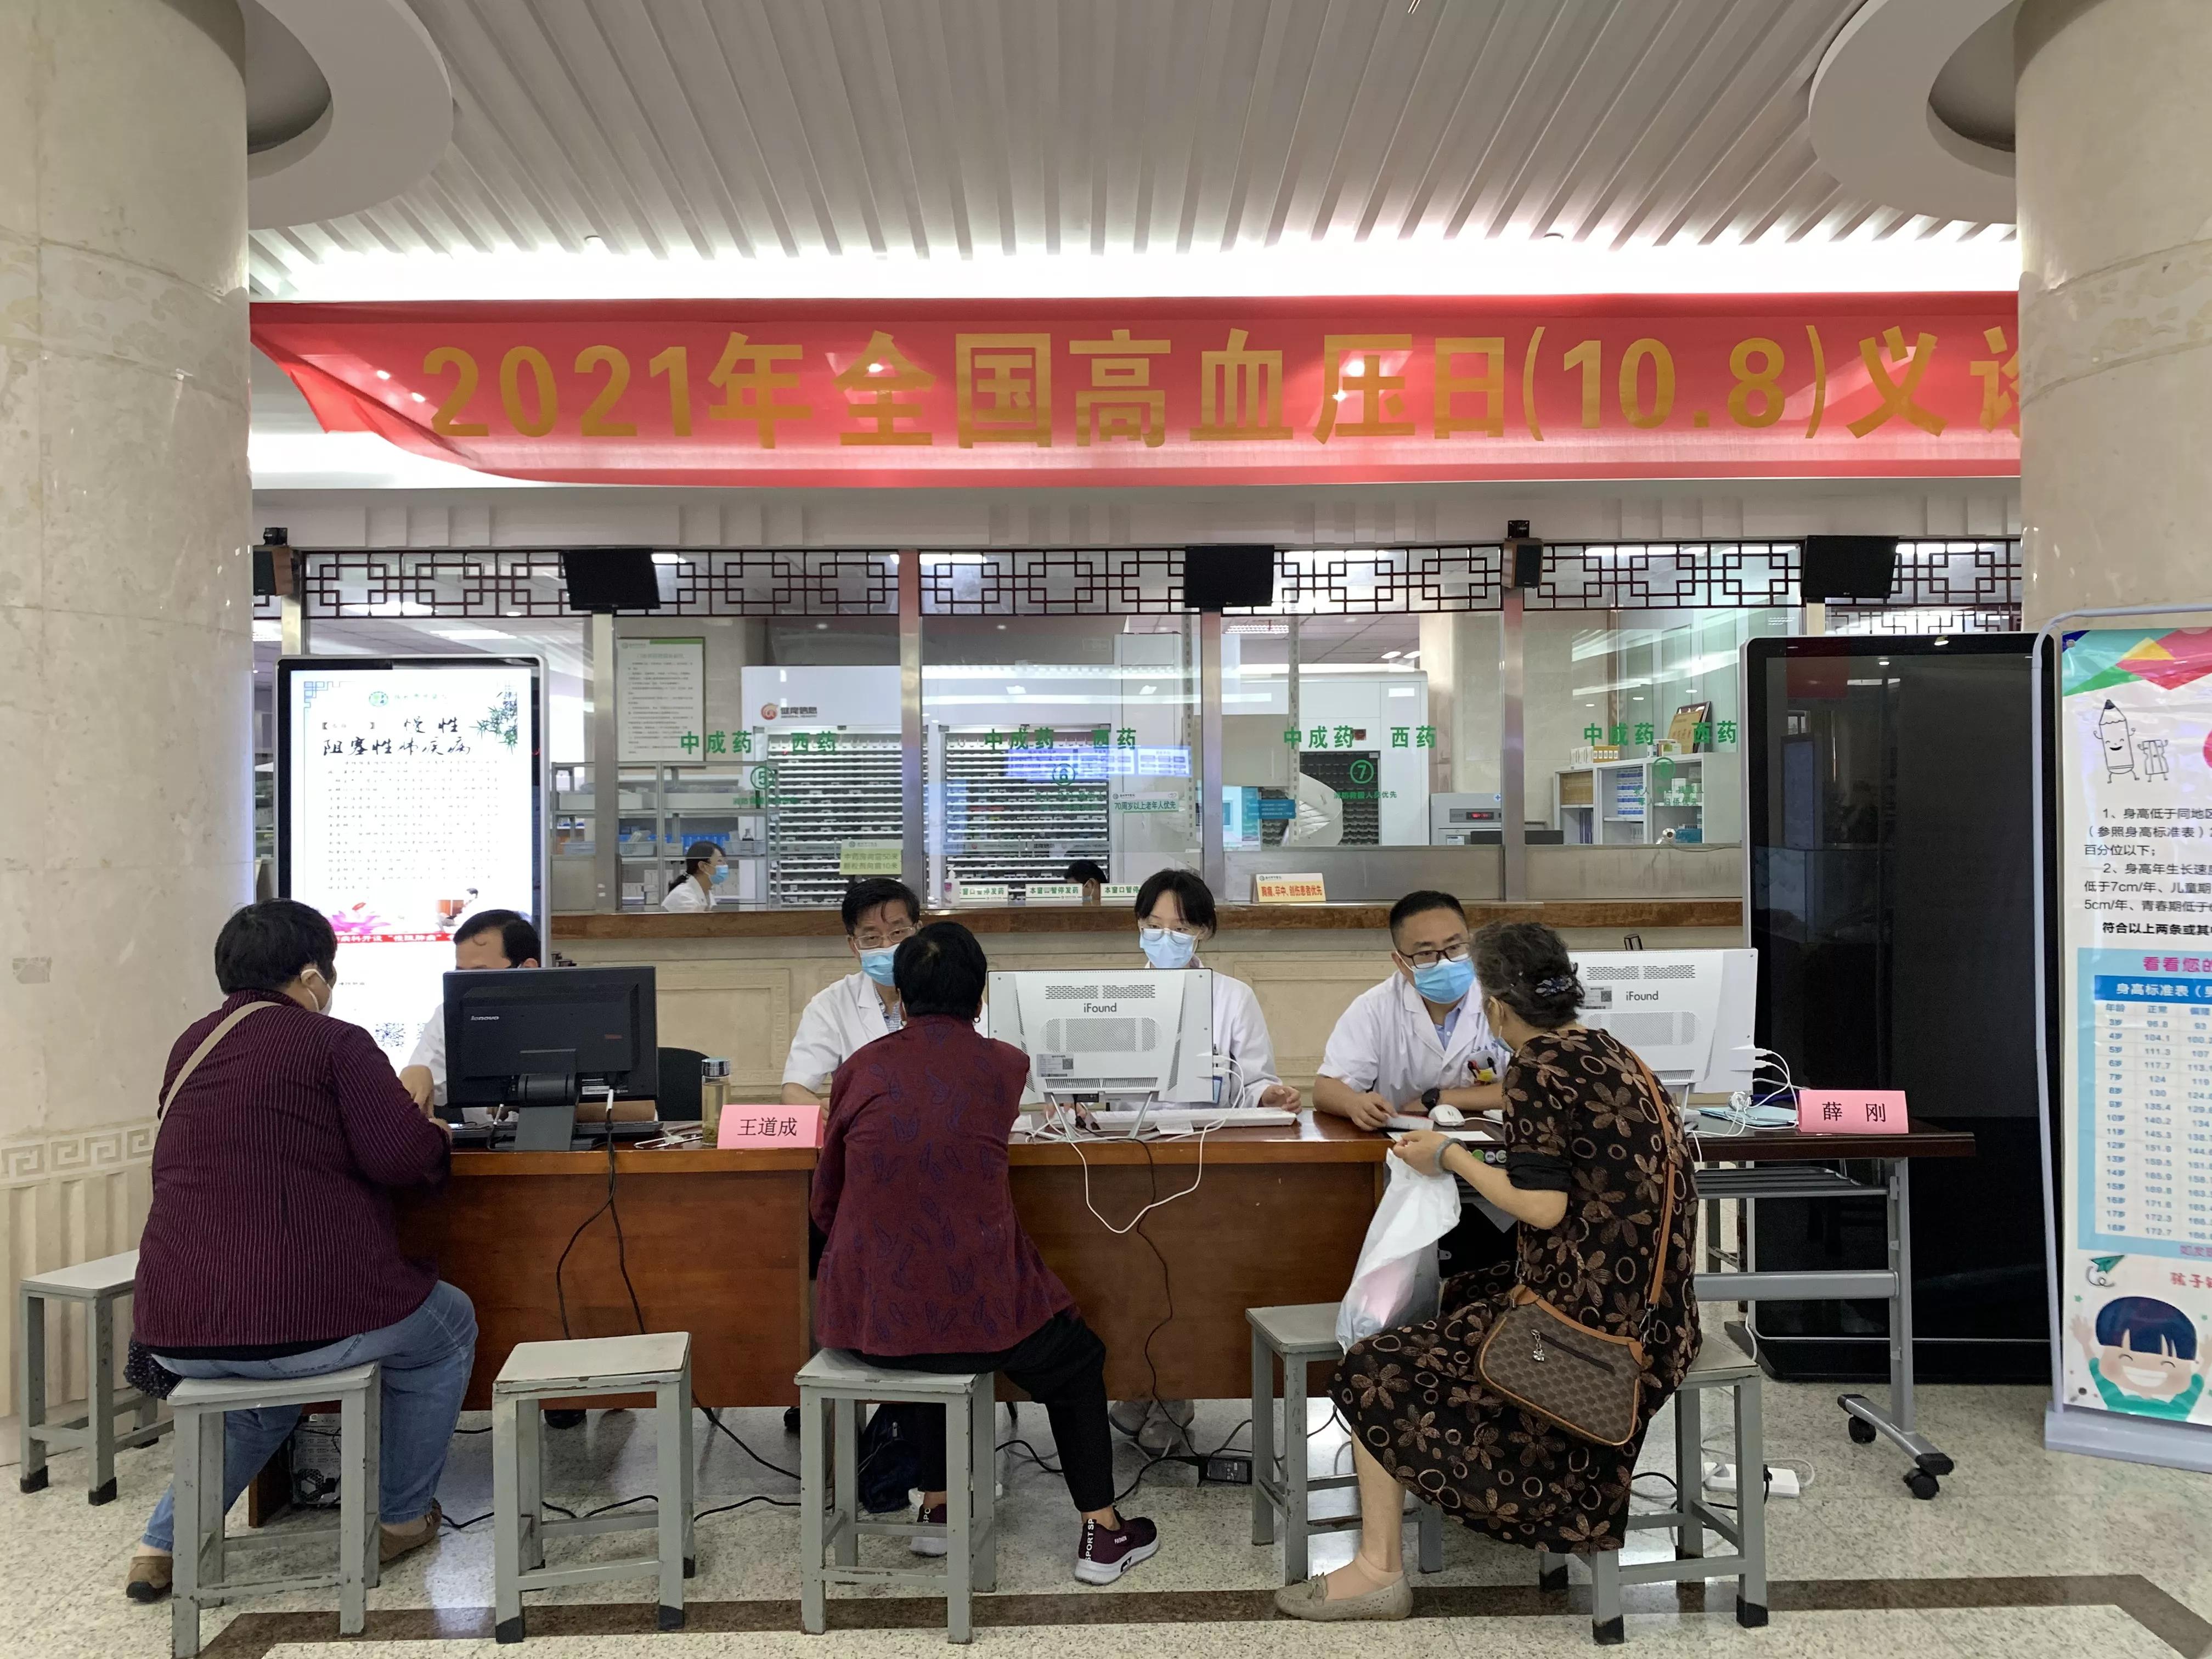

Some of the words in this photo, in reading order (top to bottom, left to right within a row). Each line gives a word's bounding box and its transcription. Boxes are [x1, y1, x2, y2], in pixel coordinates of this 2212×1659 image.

[681, 731, 752, 754] 中成药
[791, 731, 838, 754] 西药
[985, 727, 1054, 751] 中成药
[1091, 728, 1136, 749] 西药
[1284, 725, 1354, 749] 中成药
[1390, 725, 1436, 748] 西药
[1584, 723, 1654, 747] 中成药
[1692, 721, 1737, 744] 西药
[1626, 991, 1659, 1001] iFound
[1084, 1003, 1117, 1013] iFound
[737, 1117, 797, 1137] 王道成
